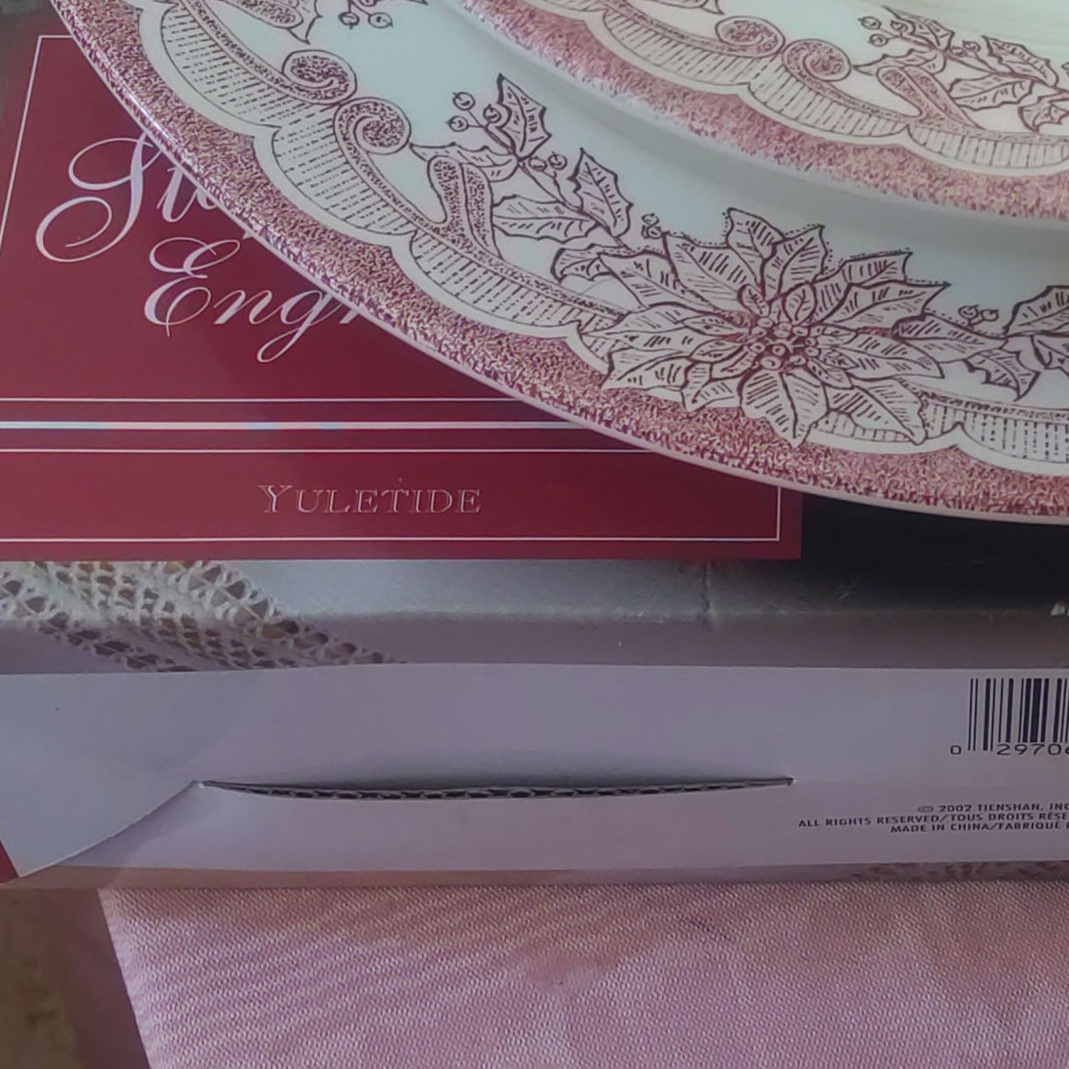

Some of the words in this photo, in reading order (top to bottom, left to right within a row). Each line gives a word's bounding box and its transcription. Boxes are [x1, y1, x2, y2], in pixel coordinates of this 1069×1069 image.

[257, 484, 482, 515] YULETIDE
[950, 745, 962, 755] 0
[938, 804, 972, 813] 2002
[798, 819, 820, 828] ALL
[825, 817, 872, 827] RIGHTS
[988, 812, 1034, 821] DROITS
[890, 824, 927, 833] MADE
[931, 823, 945, 832] IN
